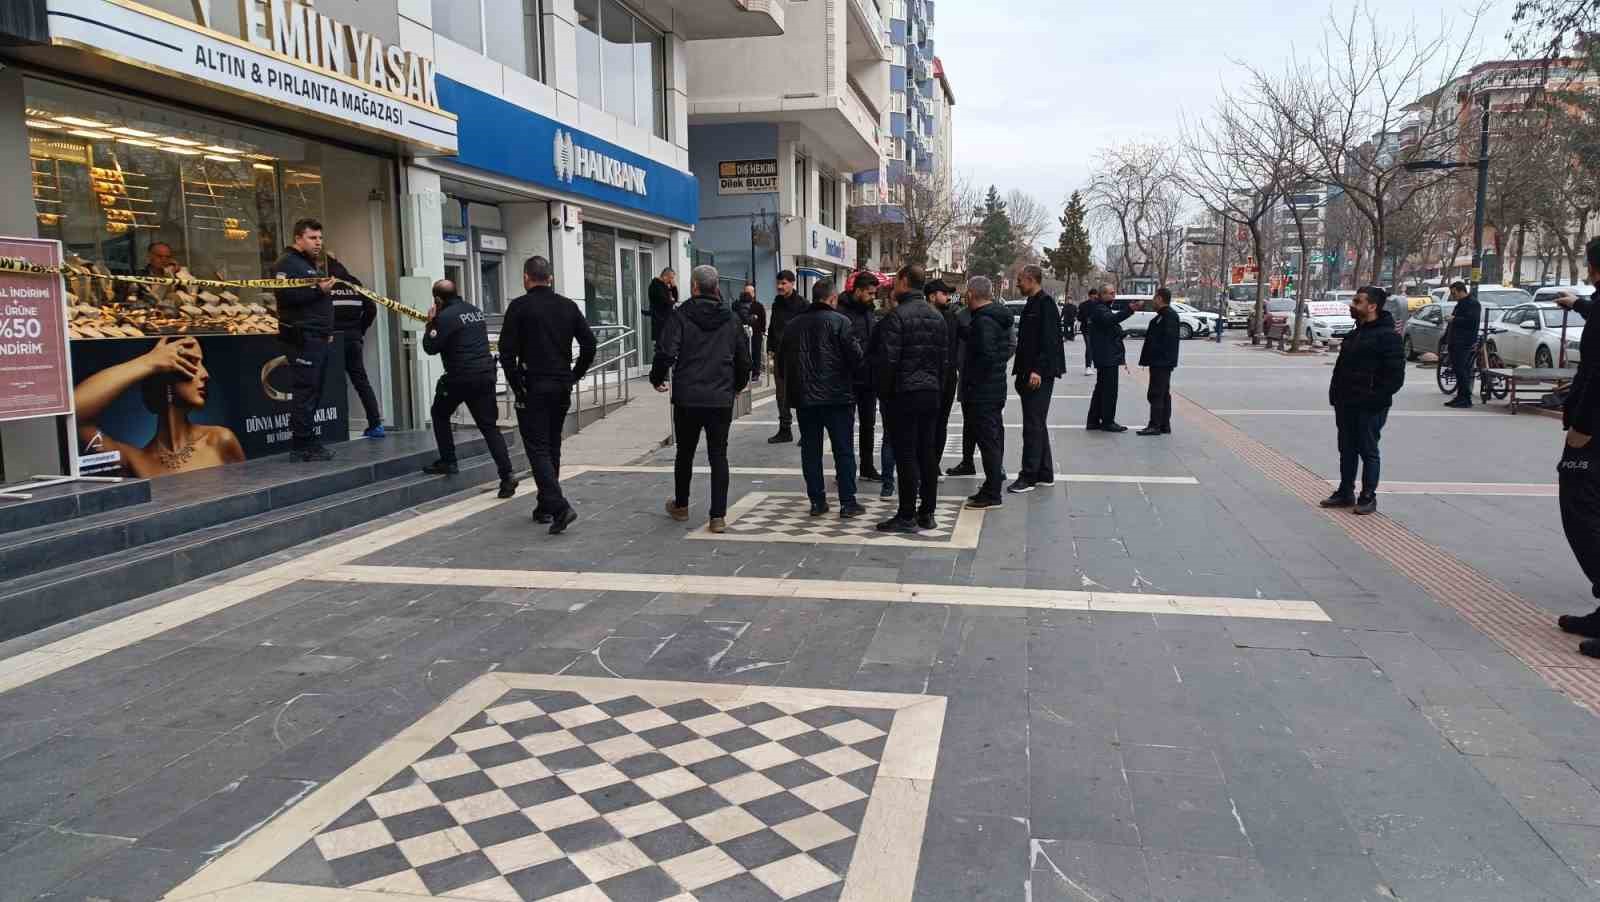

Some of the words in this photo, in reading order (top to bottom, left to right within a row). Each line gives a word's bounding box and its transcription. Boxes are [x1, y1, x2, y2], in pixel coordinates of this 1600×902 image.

[344, 25, 440, 110] YASAK
[195, 44, 246, 80] ALTIN
[251, 62, 263, 84] &
[267, 68, 339, 107] PIRLANTA
[342, 91, 403, 126] MAĞAZASI
[574, 145, 647, 197] HALKBANK
[720, 177, 744, 189] Dilek
[745, 176, 778, 188] BULUT
[4, 304, 38, 317] ÜRÜNE
[0, 318, 41, 339] %50
[246, 415, 274, 433] DÜNYA
